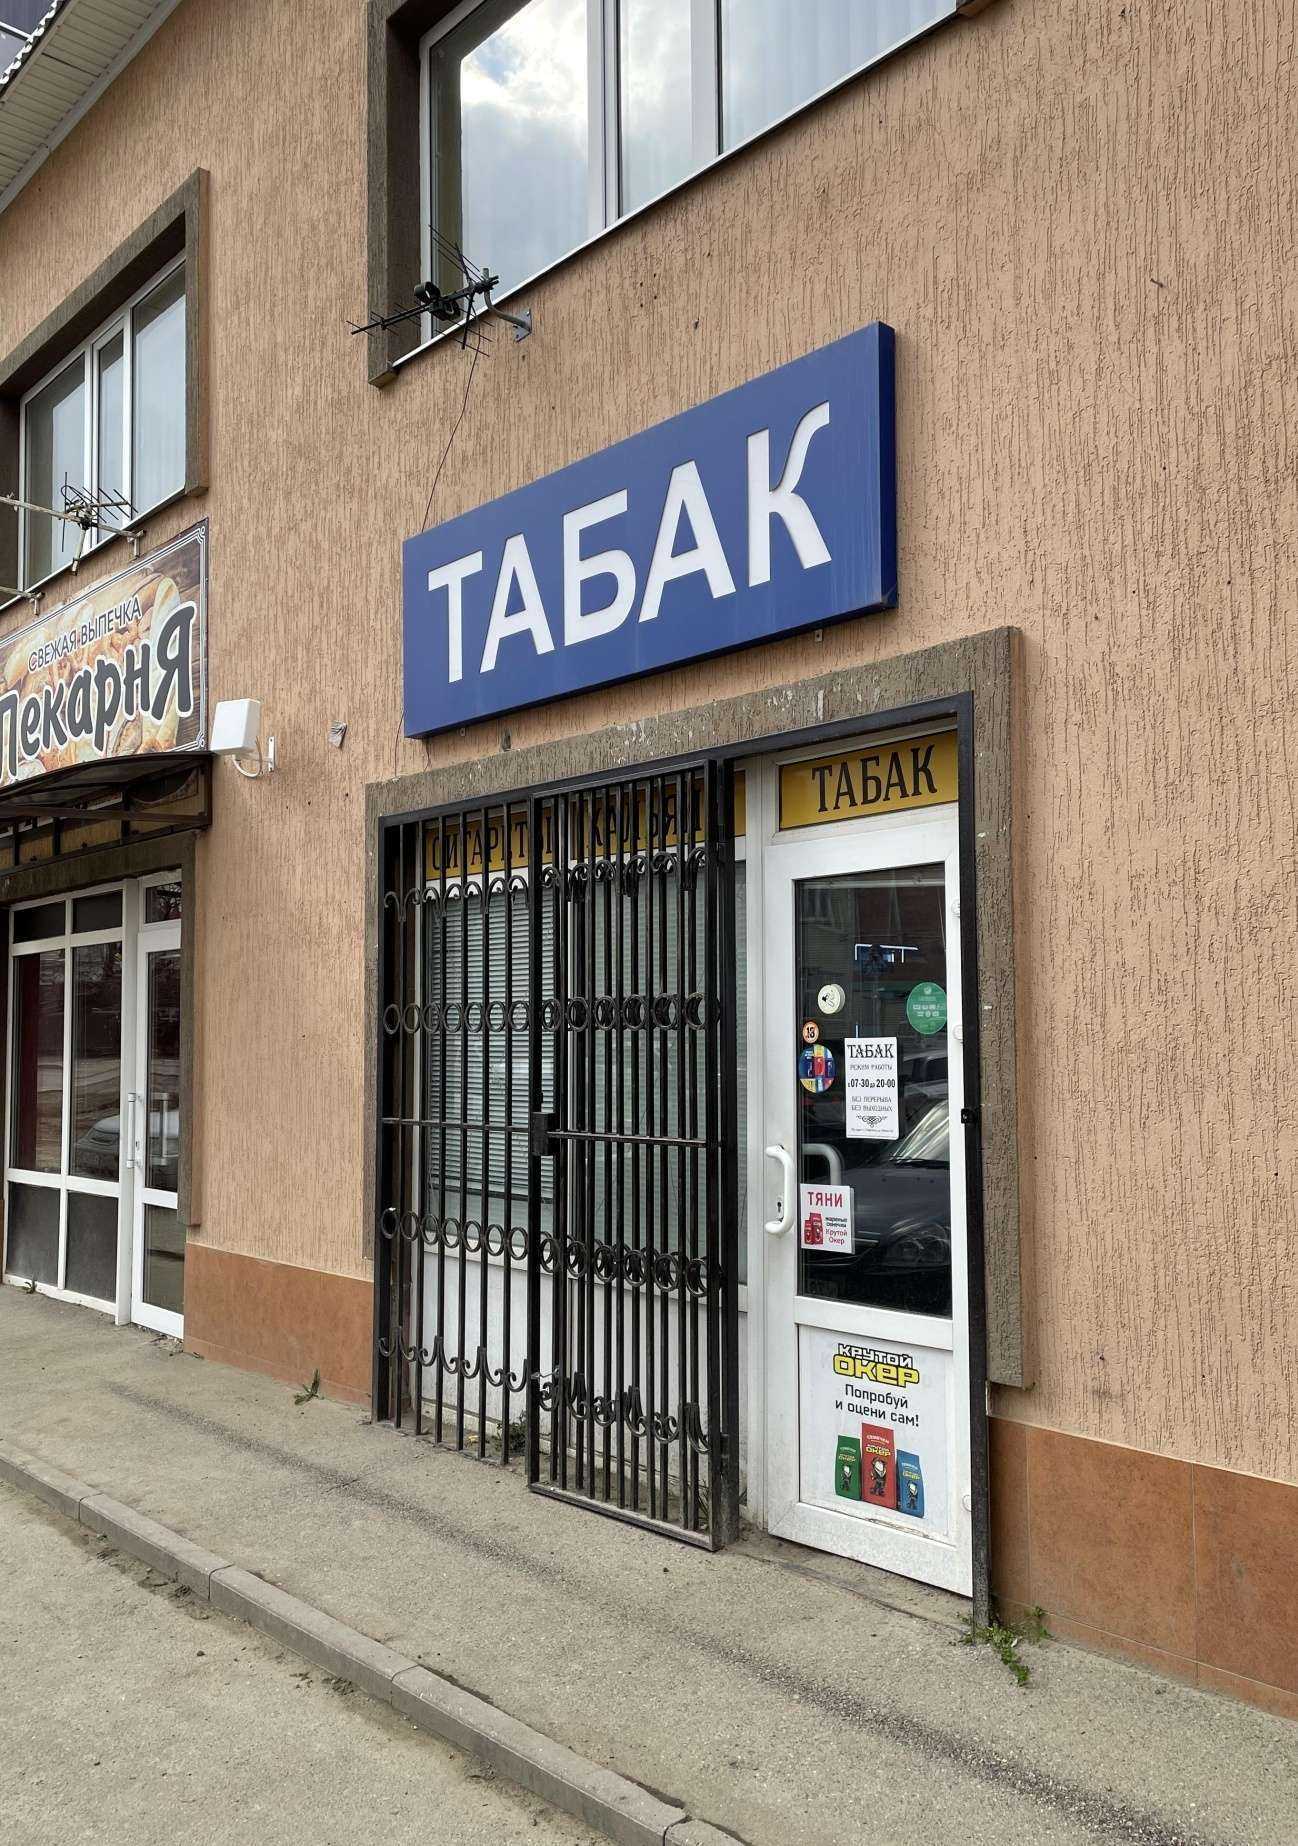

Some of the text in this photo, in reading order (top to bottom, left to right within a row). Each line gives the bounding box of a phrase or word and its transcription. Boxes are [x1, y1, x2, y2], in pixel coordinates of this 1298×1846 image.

[428, 400, 832, 683] ТАБАК
[28, 597, 142, 672] СВЕЖАЯ ВЫПЕЧКА
[811, 744, 937, 813] ТАБАК
[847, 1044, 894, 1058] ТАБАК
[807, 1192, 842, 1207] ТЯНИ
[825, 1228, 848, 1237] Крутой
[828, 1236, 845, 1246] Окер
[838, 1343, 913, 1367] КРУТОЙ
[845, 1383, 908, 1409] Попробуй
[835, 1399, 919, 1427] и оцени сам!
